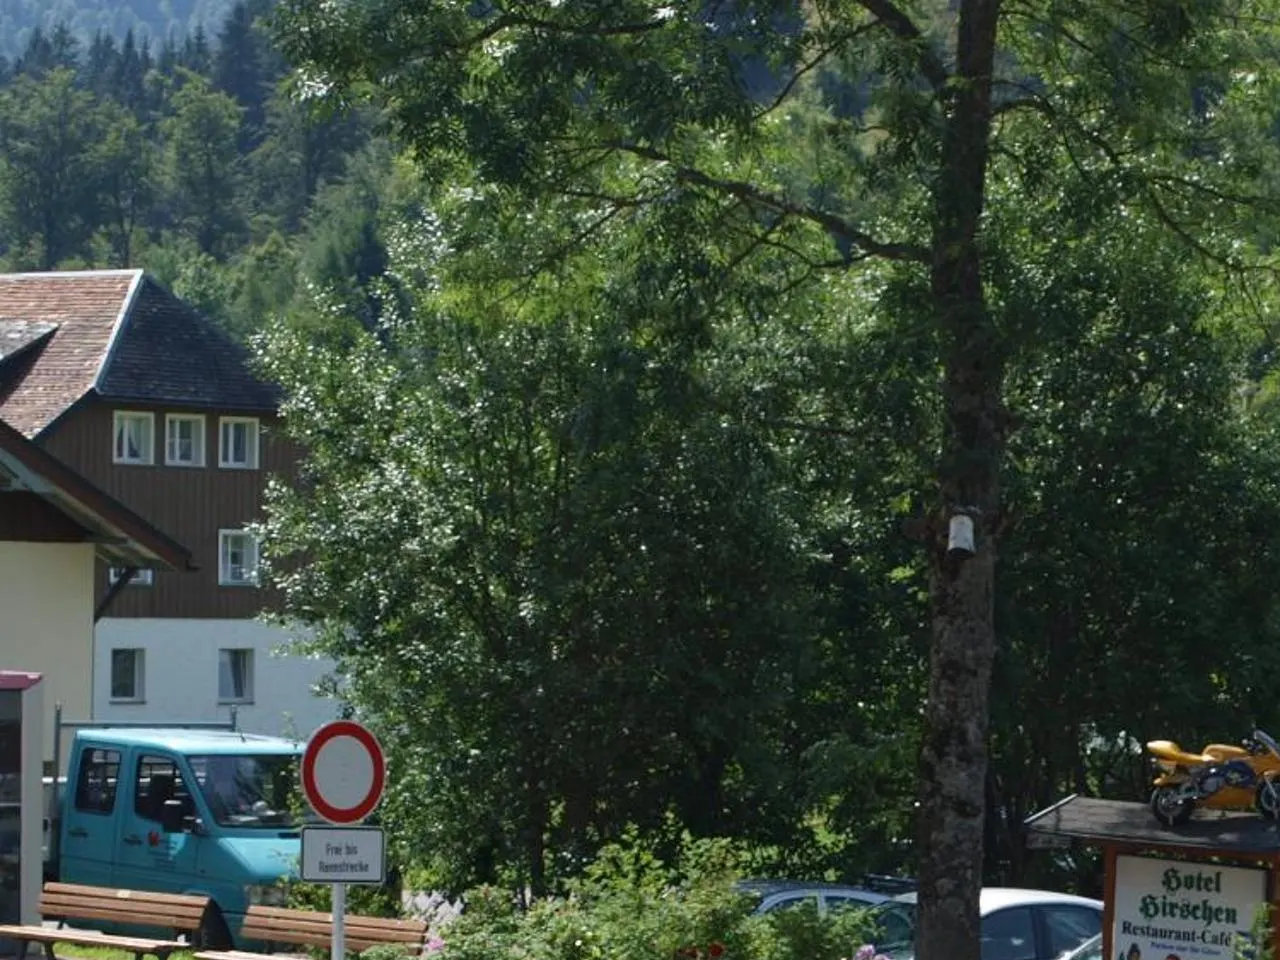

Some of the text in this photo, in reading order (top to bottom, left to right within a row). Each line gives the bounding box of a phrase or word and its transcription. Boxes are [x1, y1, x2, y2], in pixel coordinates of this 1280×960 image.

[1162, 868, 1222, 893] Hotel
[1140, 895, 1237, 926] Hirschen
[1122, 921, 1232, 947] Restaurant-Café
